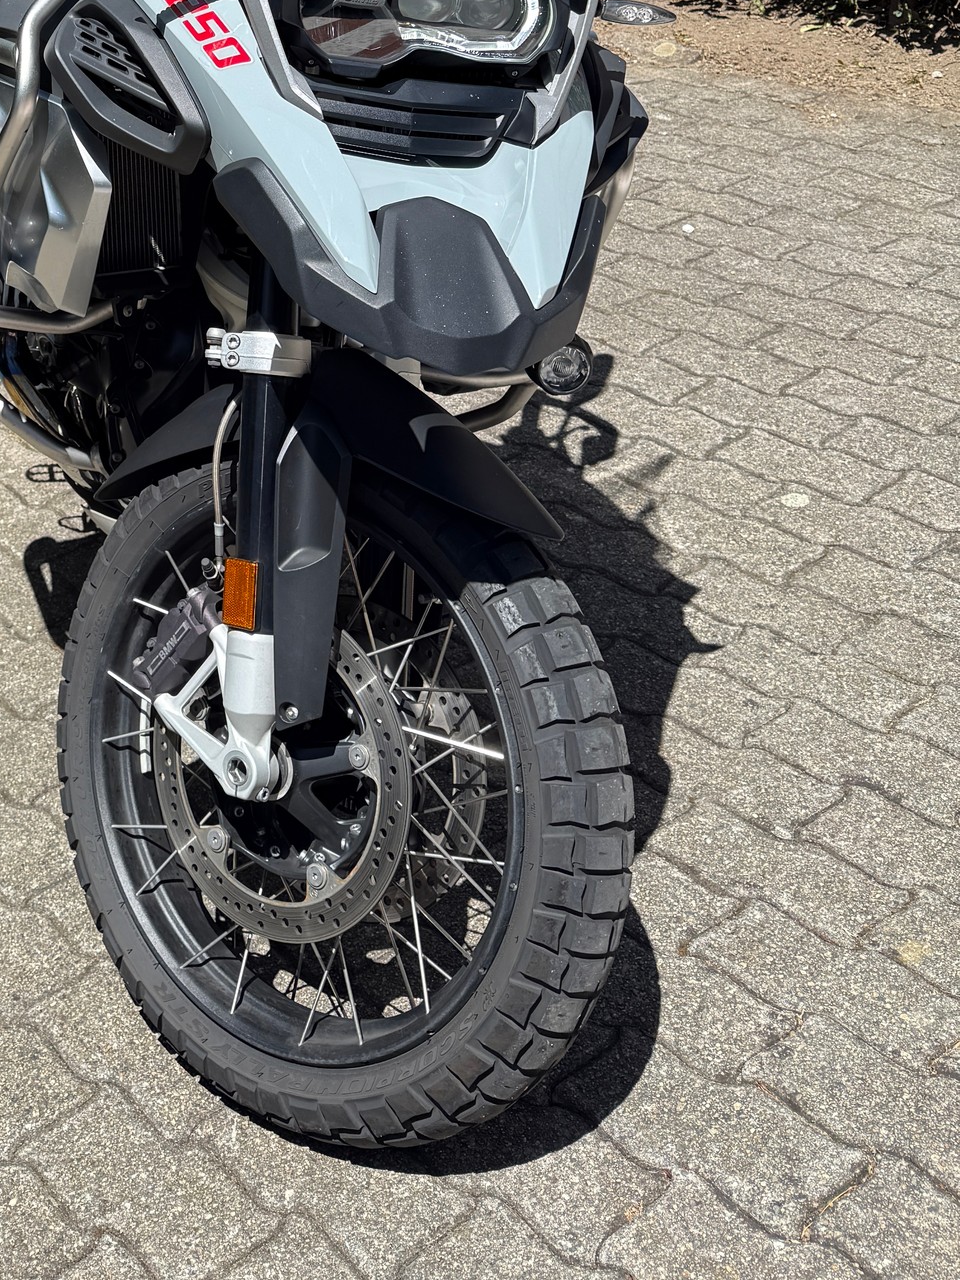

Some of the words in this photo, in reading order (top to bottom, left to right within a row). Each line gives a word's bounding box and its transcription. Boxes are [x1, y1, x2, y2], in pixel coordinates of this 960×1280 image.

[158, 634, 179, 660] BMW
[151, 976, 210, 1041] STR
[206, 1036, 313, 1093] RALLY
[317, 1009, 478, 1095] SCORPION
